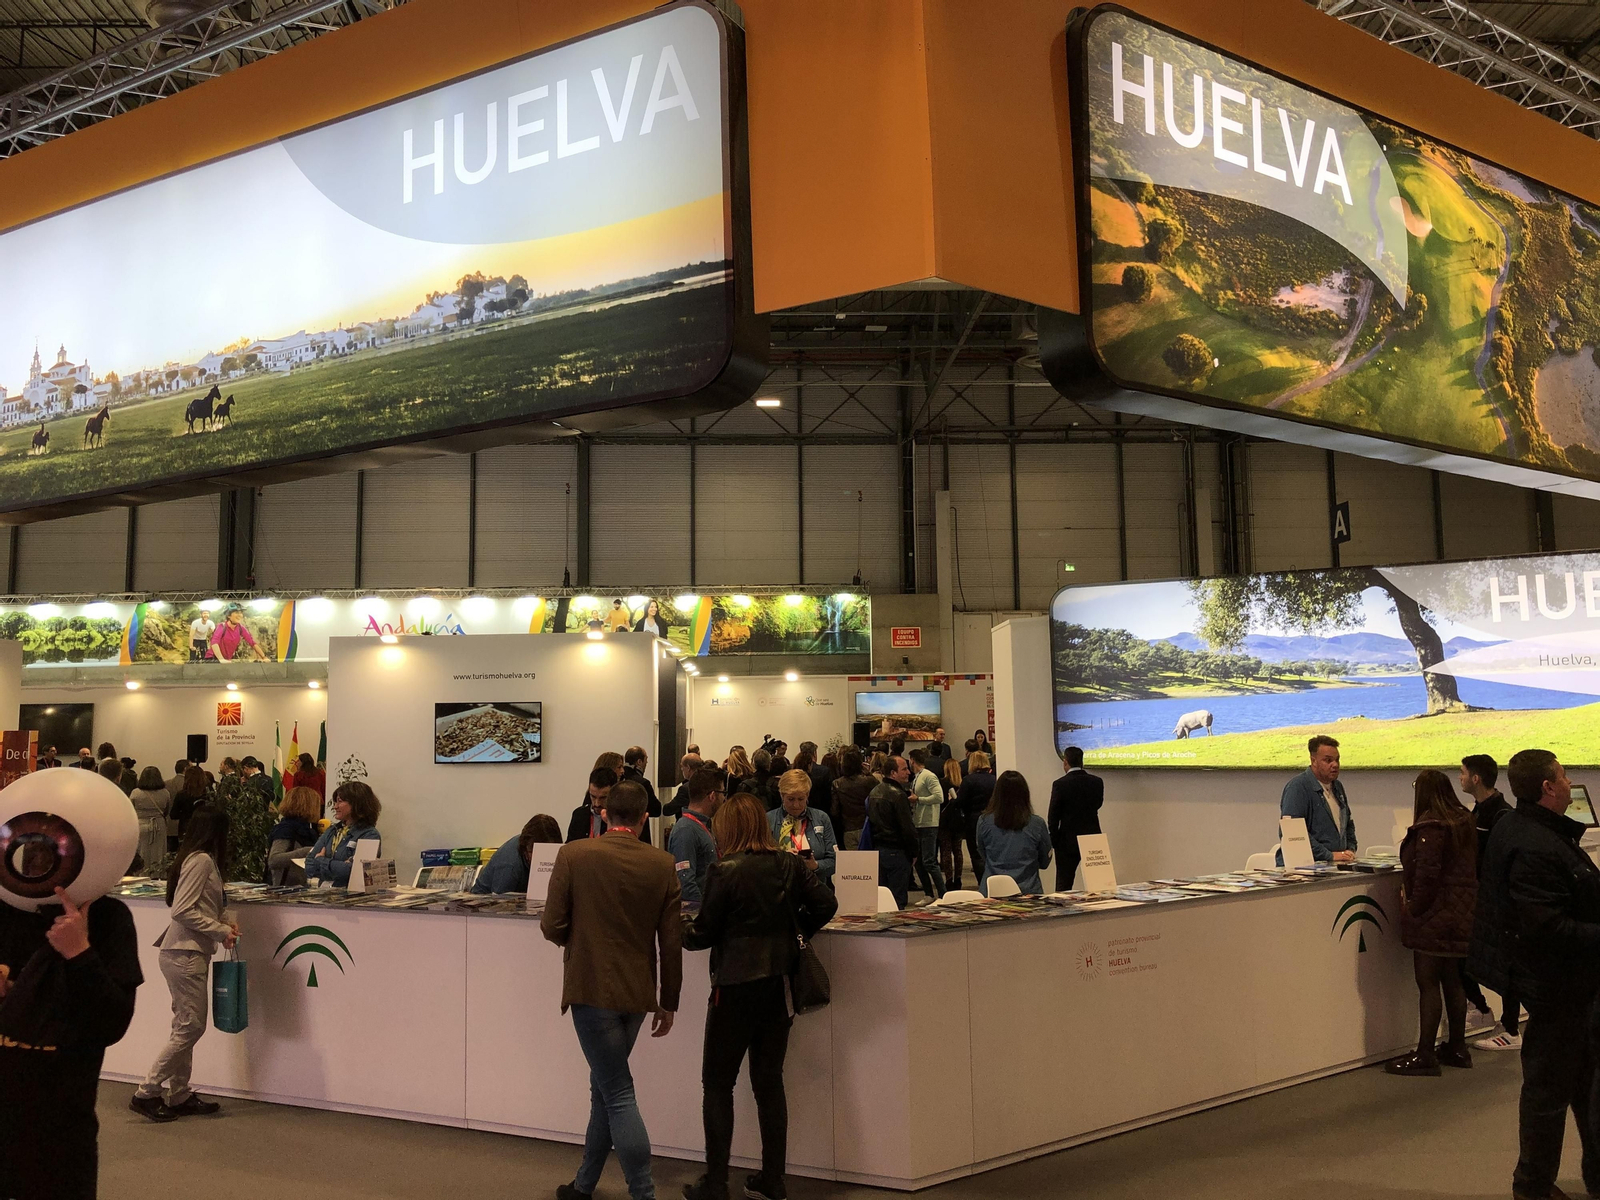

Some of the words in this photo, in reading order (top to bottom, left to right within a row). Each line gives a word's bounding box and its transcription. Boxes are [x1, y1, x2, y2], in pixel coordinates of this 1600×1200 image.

[403, 44, 700, 204] HUELVA
[1111, 41, 1354, 206] HUELVA
[1334, 510, 1347, 539] A
[1539, 653, 1597, 667] Huelva,
[453, 672, 536, 680] www.turismohuelva.org
[6, 749, 20, 760] De
[1107, 751, 1136, 759] Aracena
[1107, 937, 1135, 947] patronato
[1135, 932, 1161, 943] provincial
[1108, 949, 1115, 957] de
[1116, 947, 1138, 956] turismo
[1085, 955, 1093, 968] H
[1108, 957, 1131, 967] HUELVA
[1108, 966, 1138, 976] convention
[1139, 963, 1158, 972] bureau
